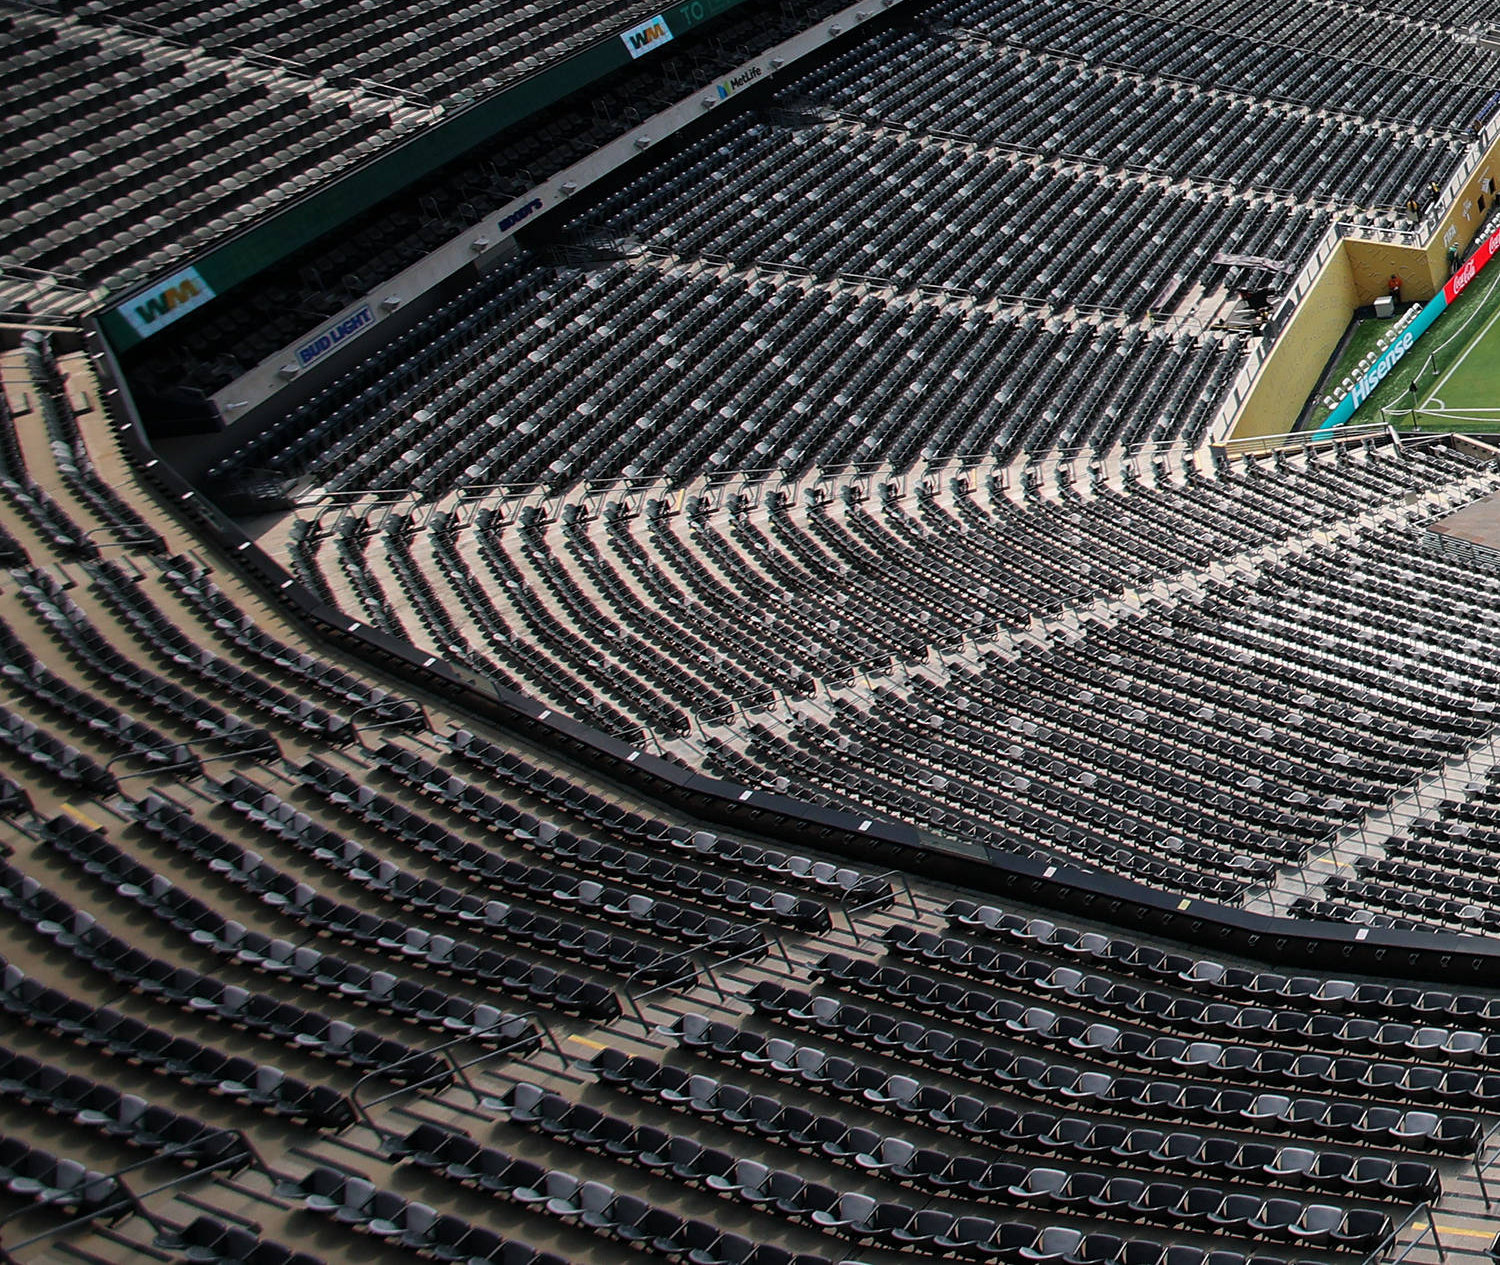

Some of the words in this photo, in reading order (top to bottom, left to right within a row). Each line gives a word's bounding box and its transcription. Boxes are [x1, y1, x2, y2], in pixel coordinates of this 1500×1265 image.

[629, 24, 666, 50] WM
[730, 65, 763, 91] MetLife
[136, 278, 200, 325] WM
[300, 332, 330, 366] BUD
[329, 306, 372, 347] LIGHT
[1351, 331, 1414, 410] Hisense
